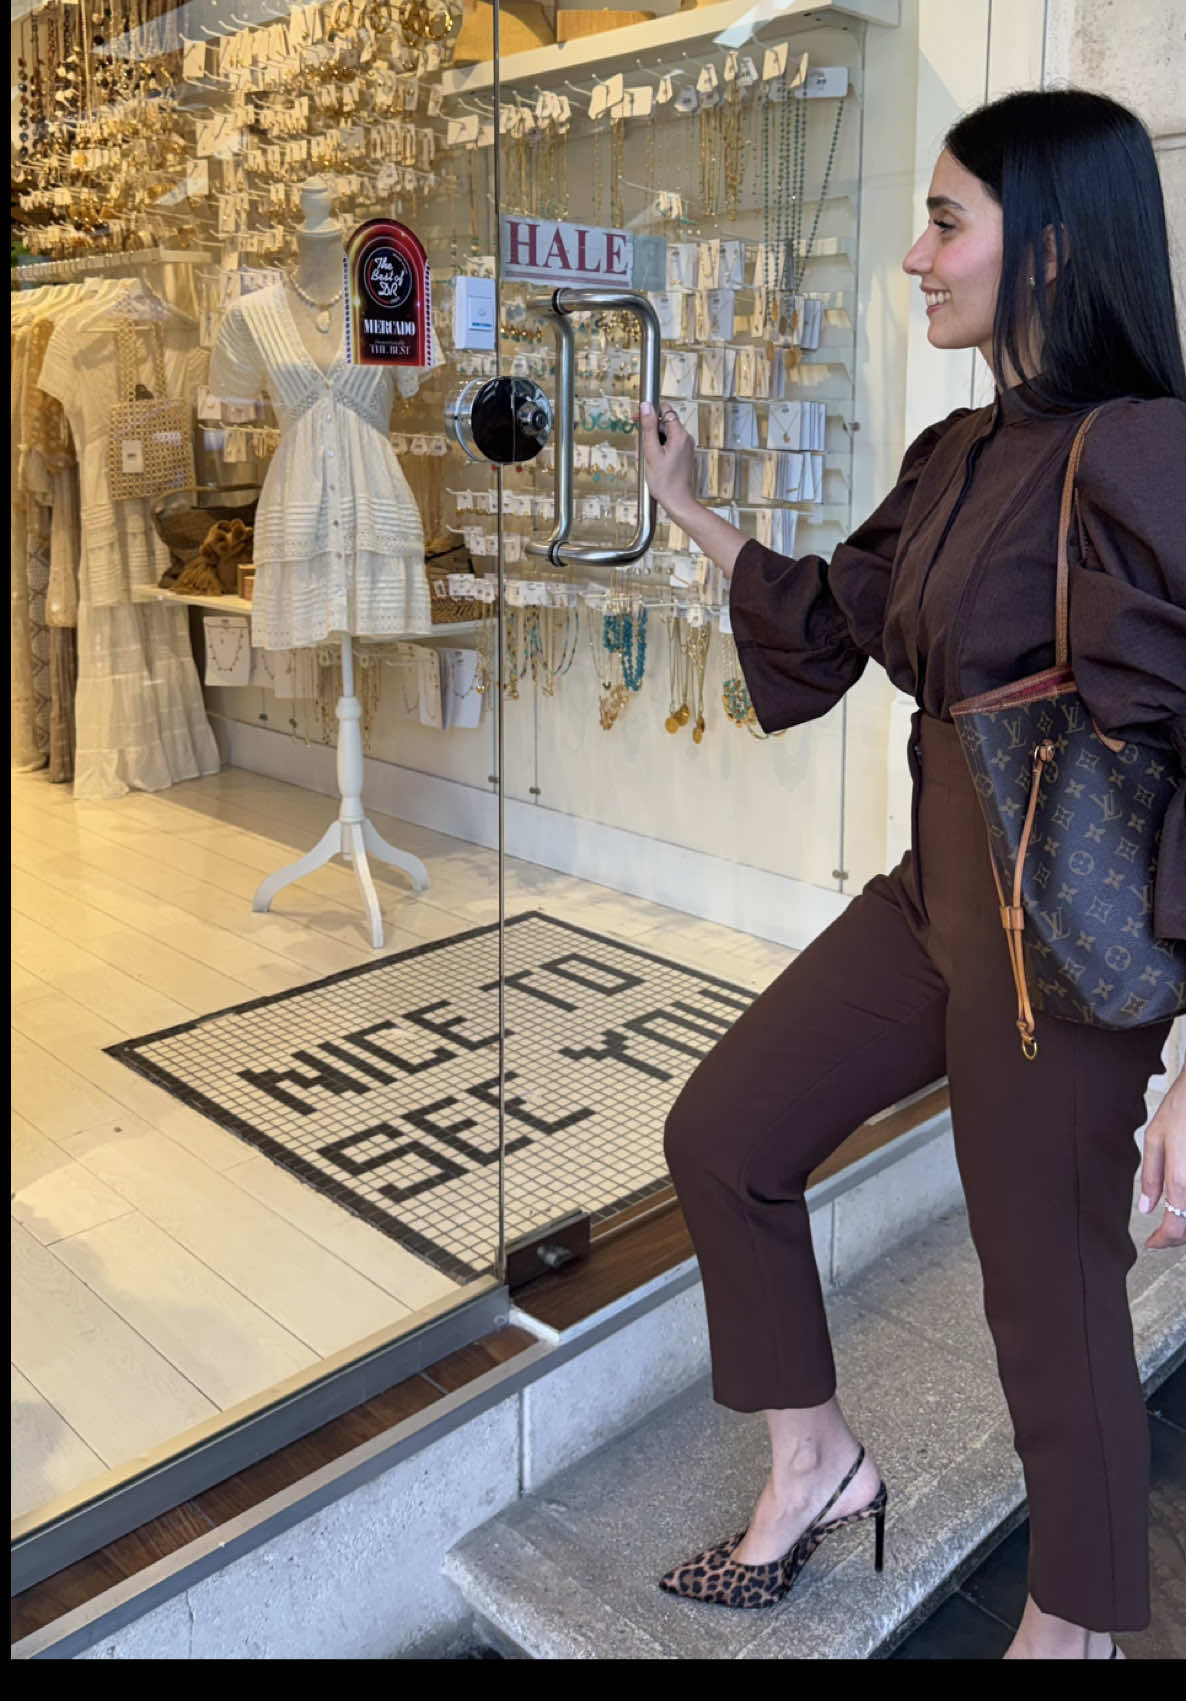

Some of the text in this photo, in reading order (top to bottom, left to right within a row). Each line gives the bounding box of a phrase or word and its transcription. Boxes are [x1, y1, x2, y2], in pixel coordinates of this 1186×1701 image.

[374, 257, 393, 270] The
[507, 220, 629, 275] HALE
[371, 268, 405, 286] Best of
[363, 318, 416, 336] MERCADO
[236, 952, 645, 1116] NICE TO
[316, 1071, 597, 1204] SEE
